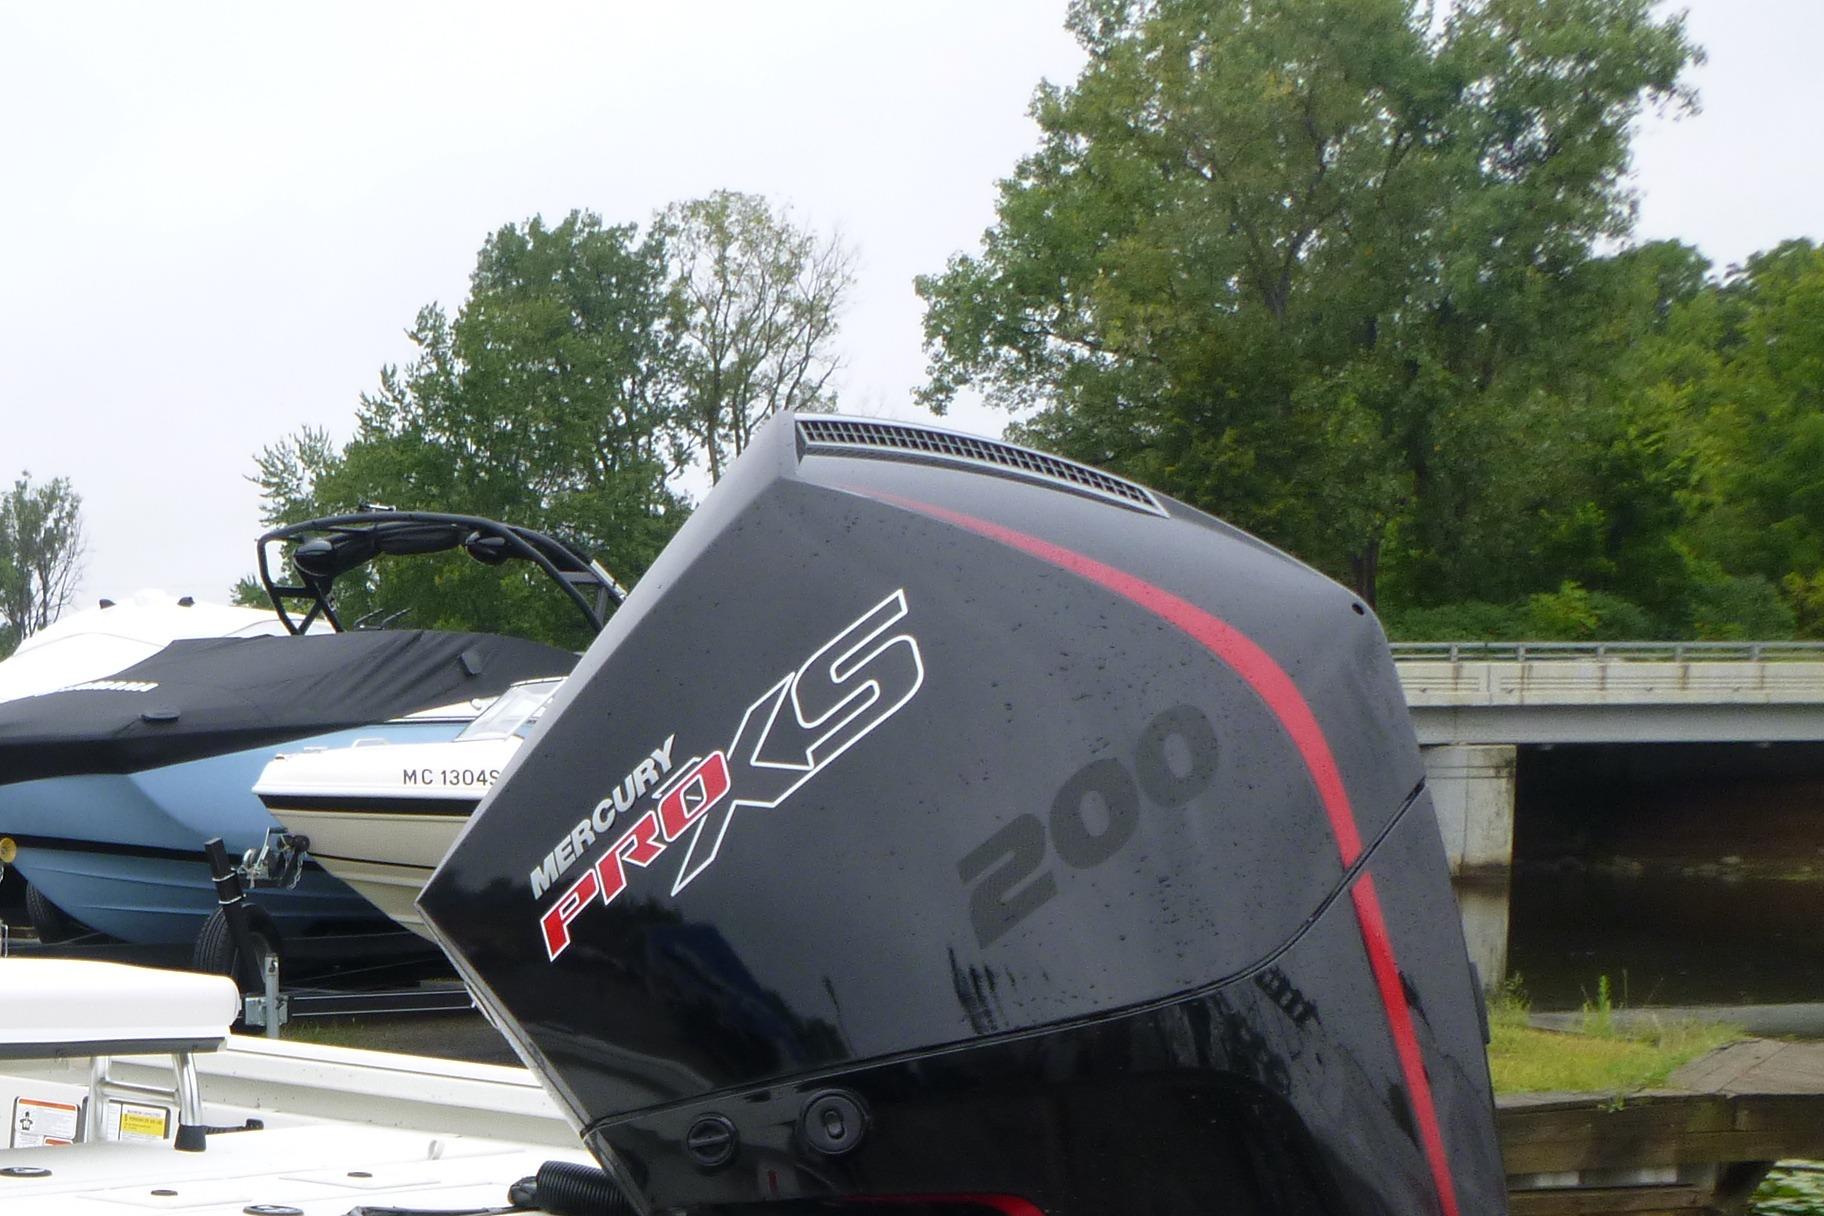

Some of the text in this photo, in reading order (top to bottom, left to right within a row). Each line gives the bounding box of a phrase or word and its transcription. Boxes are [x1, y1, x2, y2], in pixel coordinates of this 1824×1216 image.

[402, 768, 434, 786] MC
[529, 733, 676, 901] MERCURY
[540, 749, 732, 964] PRO
[955, 703, 1220, 951] 200
